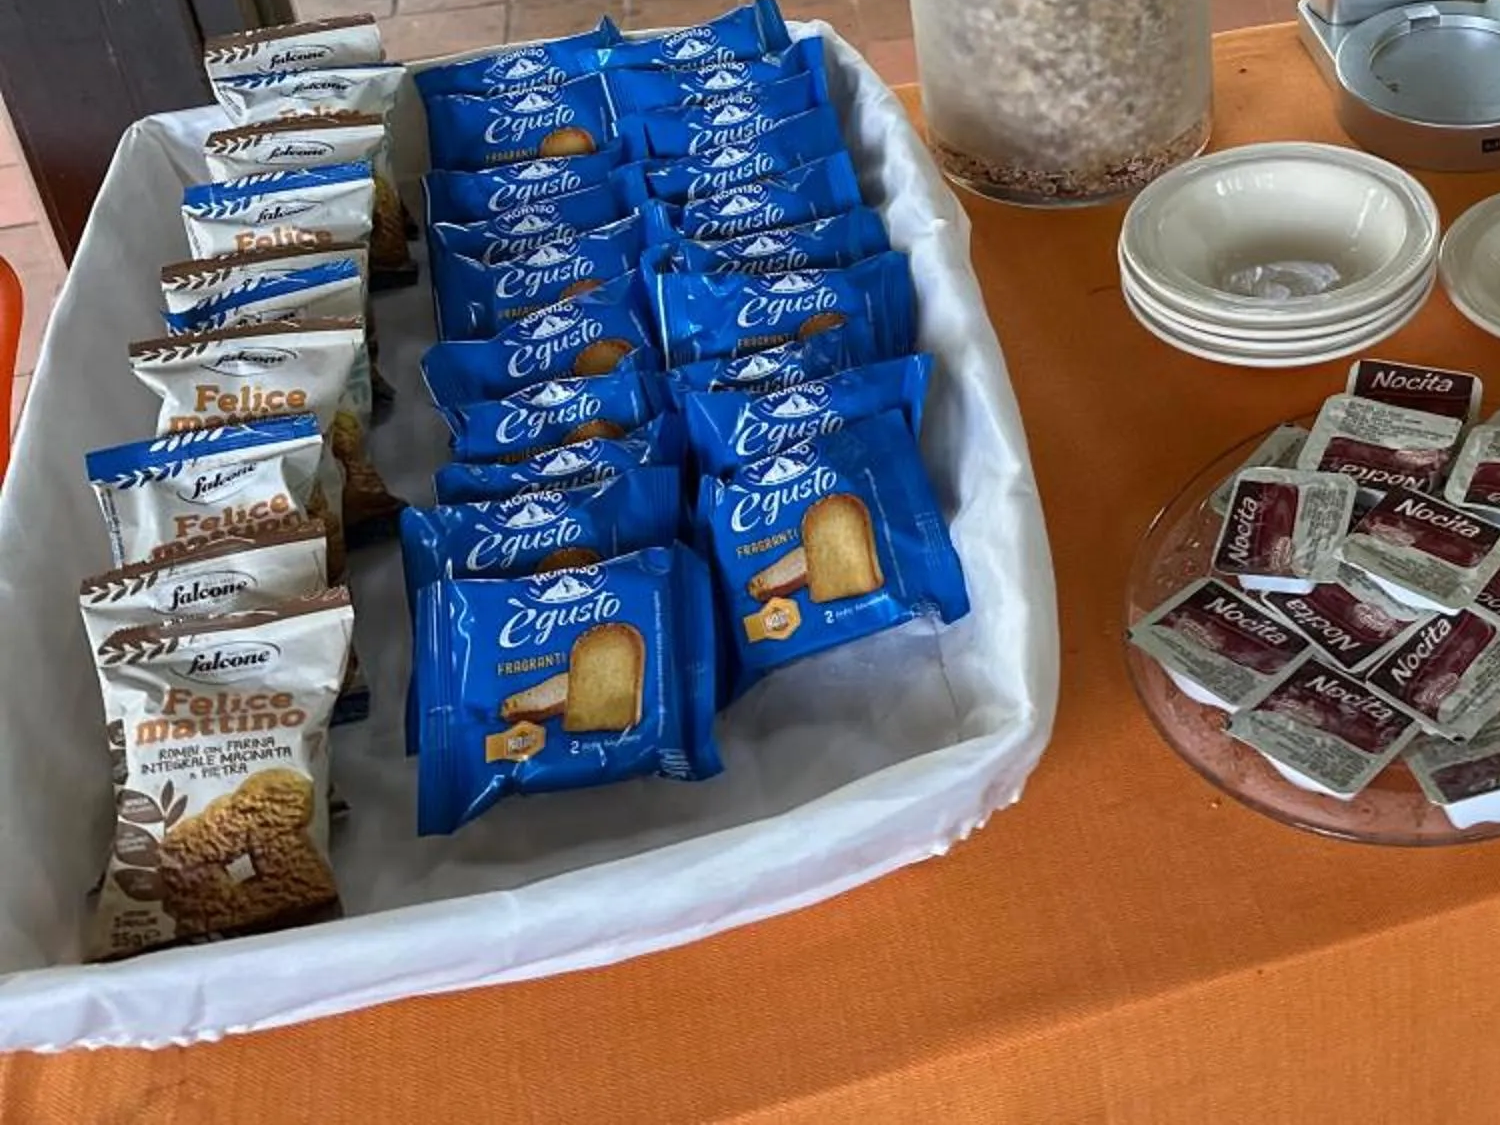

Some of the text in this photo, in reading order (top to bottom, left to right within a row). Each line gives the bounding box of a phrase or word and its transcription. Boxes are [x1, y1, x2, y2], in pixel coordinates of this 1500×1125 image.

[667, 27, 712, 48] MONVISO
[498, 47, 546, 68] MONVISO
[713, 184, 763, 204] MONVISO
[503, 203, 556, 223] MONVISO
[1371, 369, 1454, 394] Nocita
[194, 384, 308, 414] Felice
[1340, 463, 1427, 496] Nocita
[173, 493, 291, 539] Felice
[501, 491, 563, 513] MONVISO
[1228, 495, 1259, 571] Nocita
[1394, 497, 1481, 540] Nocita
[168, 577, 249, 612] falcone
[1204, 597, 1288, 646] Nocita
[1287, 597, 1361, 653] Nocita
[187, 647, 273, 676] falcone
[497, 652, 569, 676] FRAGRANTI
[1390, 617, 1451, 686] Nocita
[161, 688, 295, 717] Felice
[1305, 674, 1393, 721] Nocita
[134, 708, 307, 747] mattino
[219, 745, 293, 765] MACINATA
[226, 736, 276, 754] FARINA
